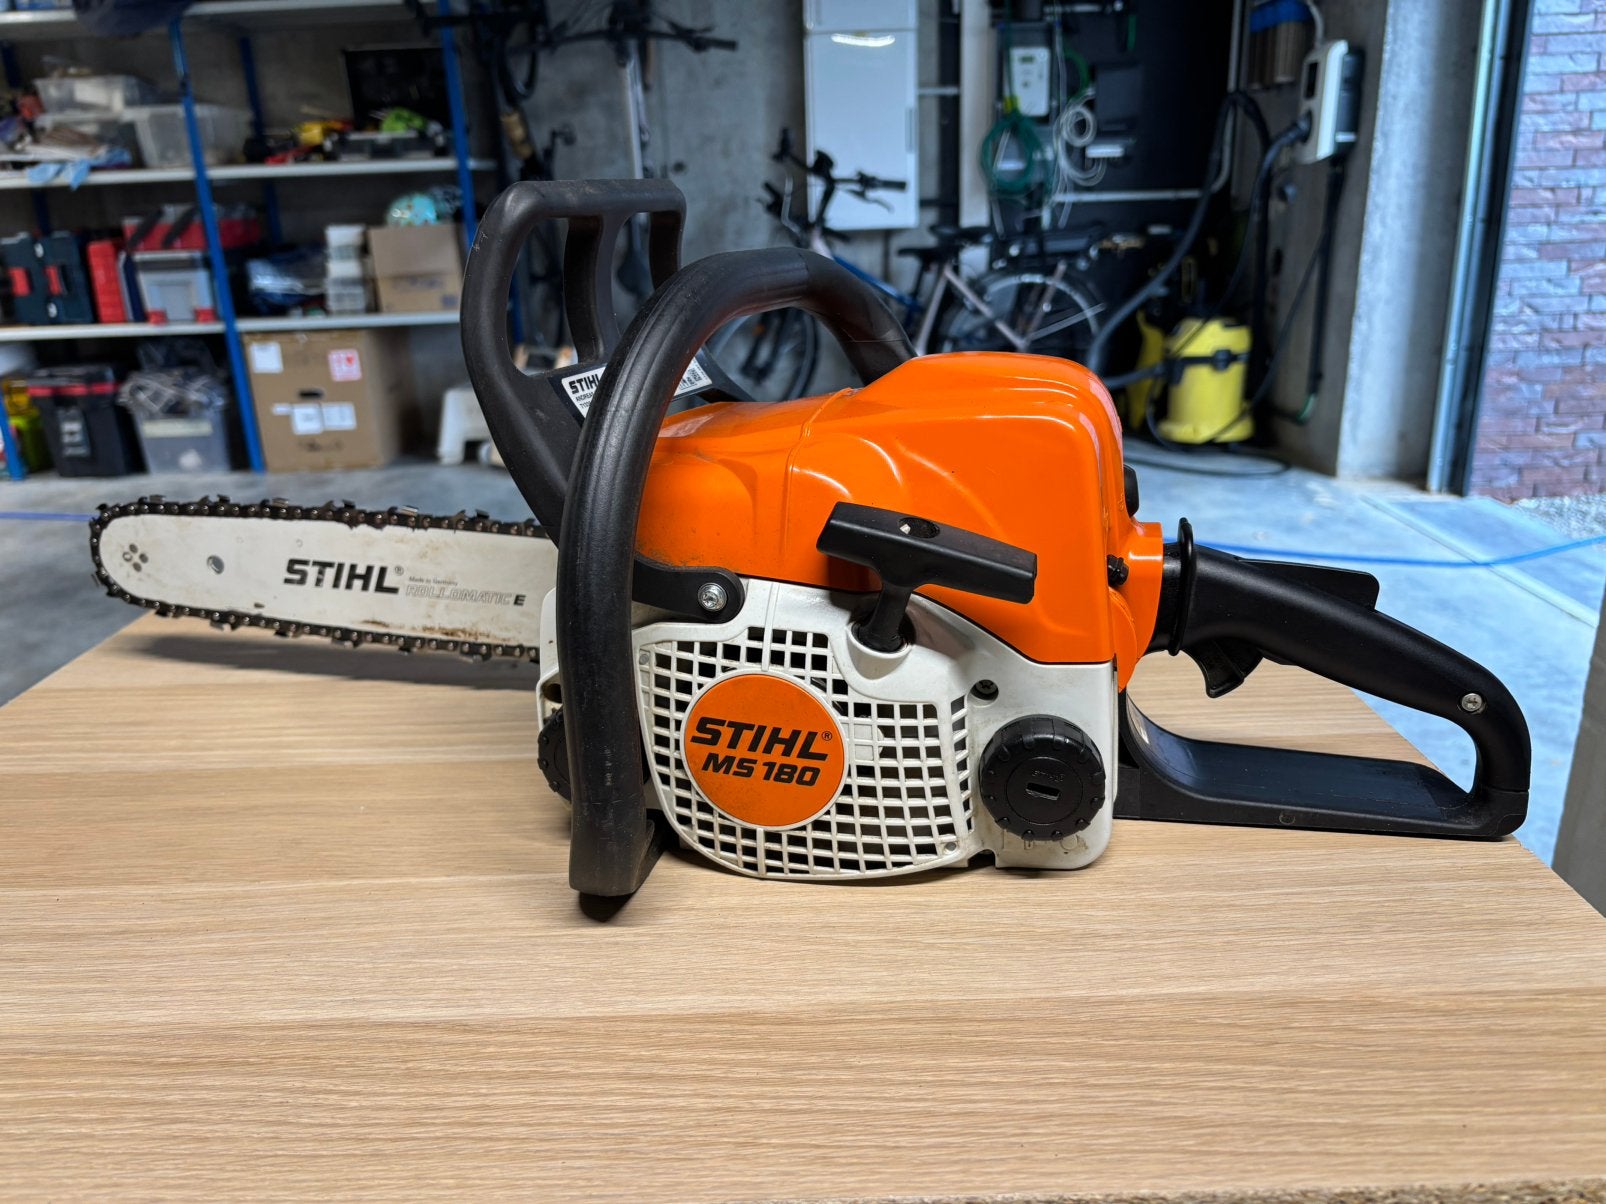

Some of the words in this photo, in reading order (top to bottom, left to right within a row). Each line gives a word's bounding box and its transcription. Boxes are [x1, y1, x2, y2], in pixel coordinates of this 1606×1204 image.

[513, 594, 527, 606] E
[701, 752, 758, 778] MS
[762, 761, 821, 787] 180
